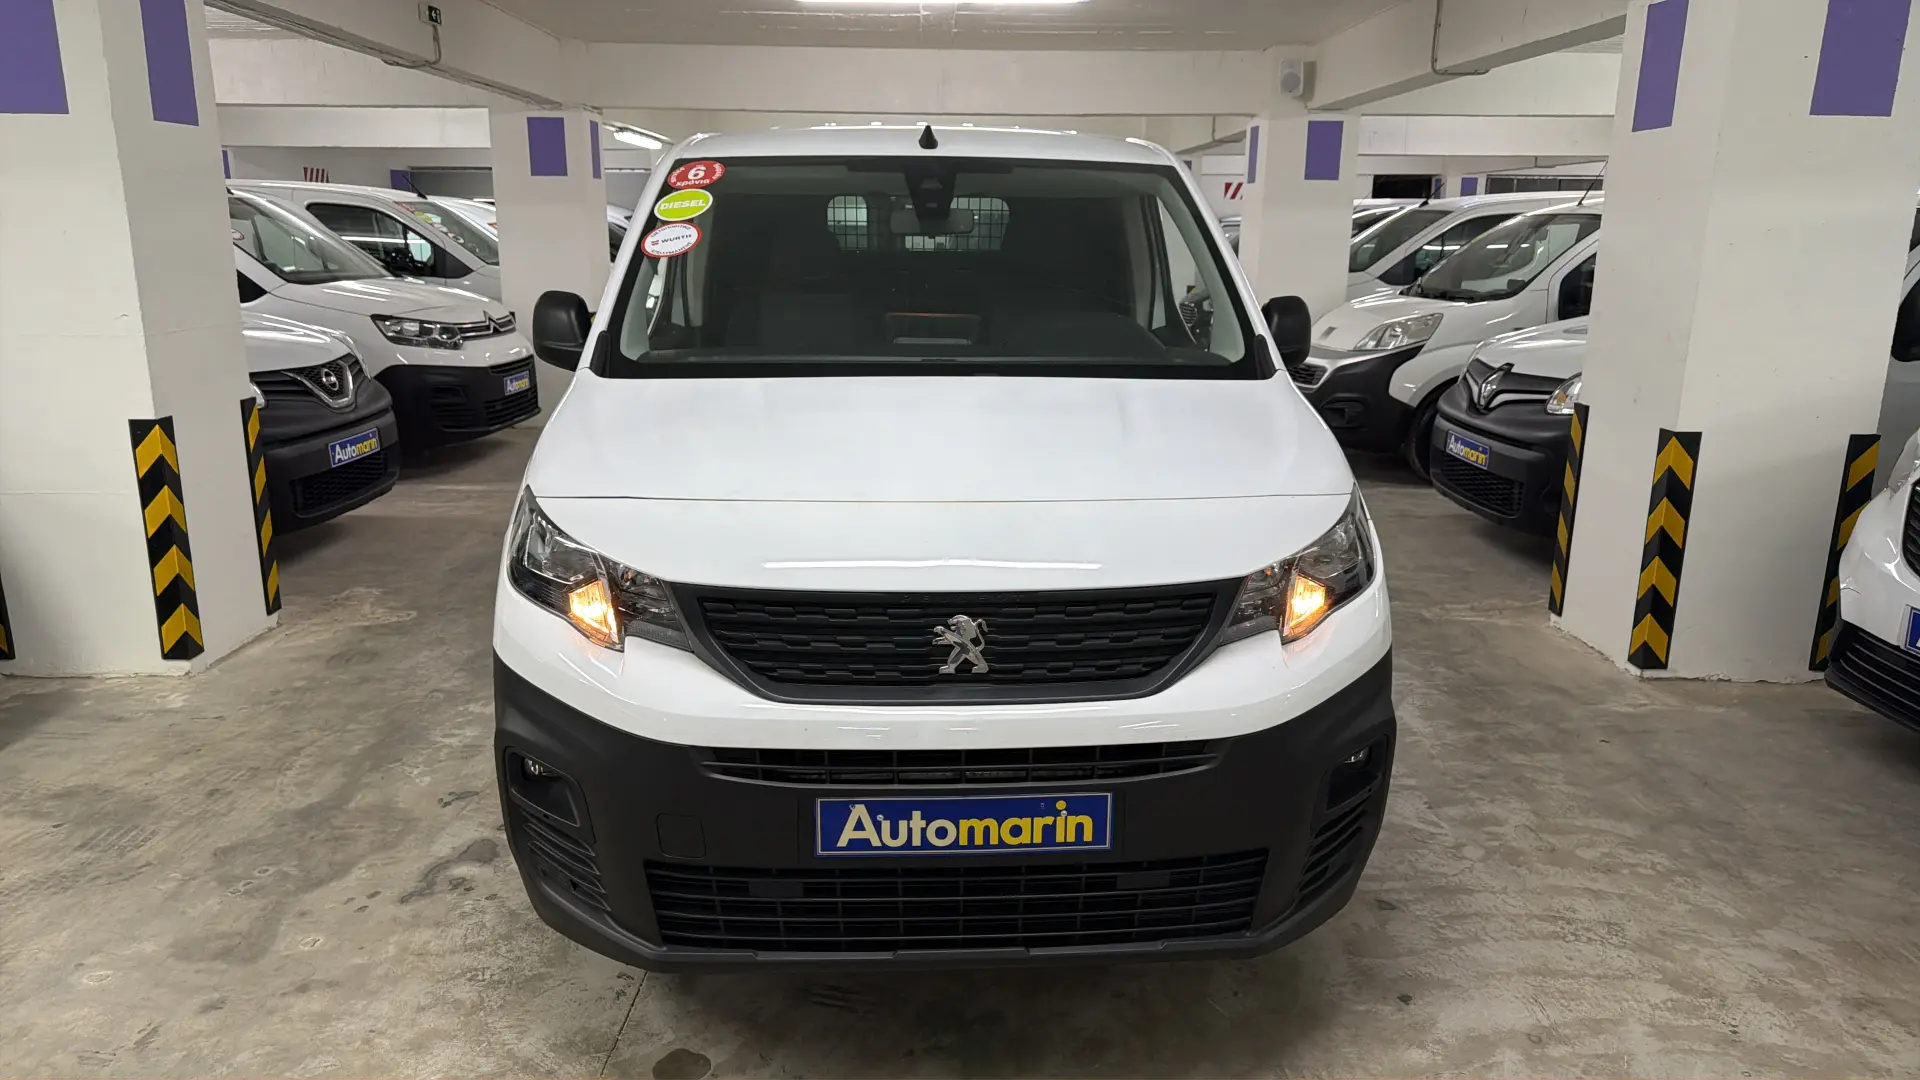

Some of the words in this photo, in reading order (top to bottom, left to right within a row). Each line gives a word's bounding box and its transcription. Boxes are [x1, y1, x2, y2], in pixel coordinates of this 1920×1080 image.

[675, 178, 711, 187] χρόνια
[688, 166, 707, 180] 6
[659, 199, 707, 210] DIESEL
[335, 433, 378, 463] Automarin
[1448, 434, 1486, 465] Automarin
[836, 800, 1093, 847] Automarin
